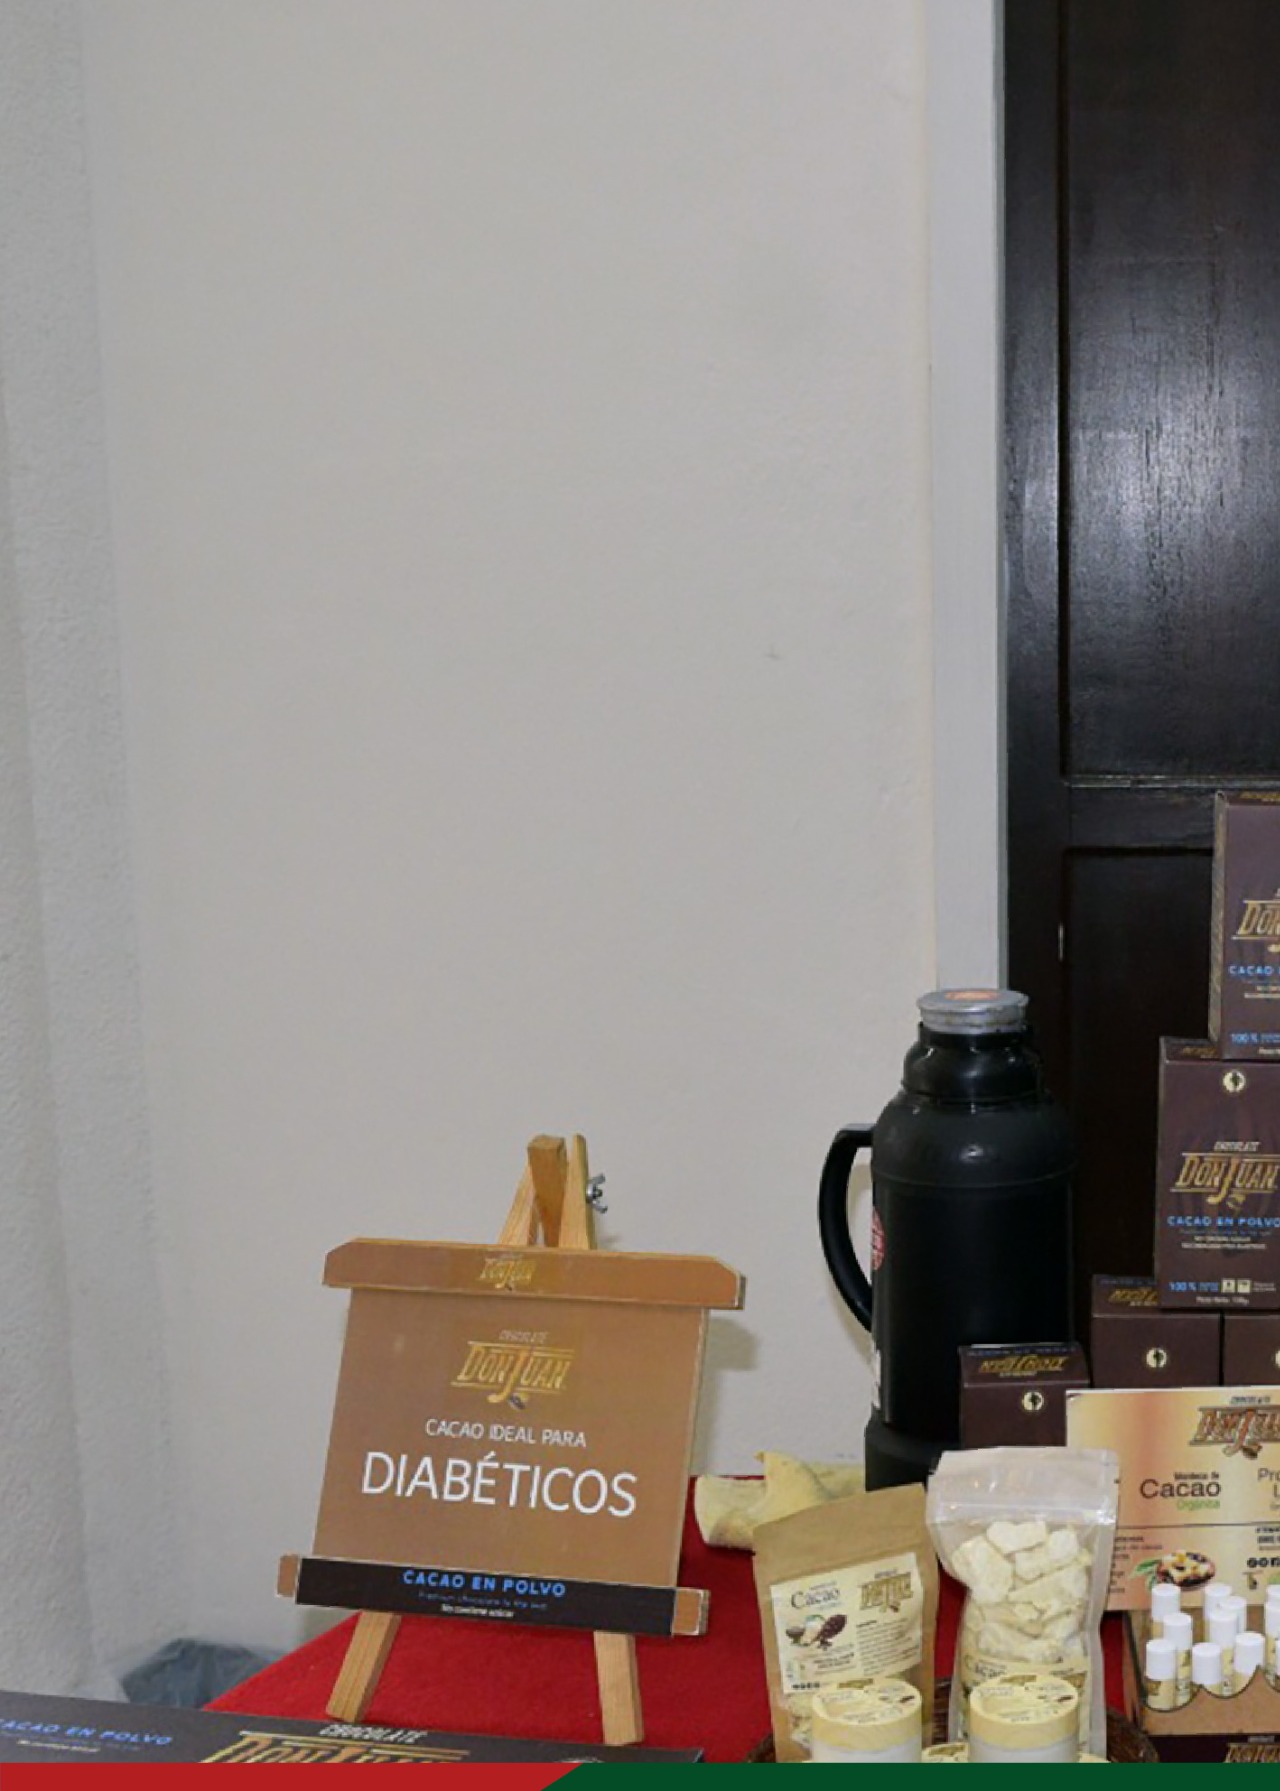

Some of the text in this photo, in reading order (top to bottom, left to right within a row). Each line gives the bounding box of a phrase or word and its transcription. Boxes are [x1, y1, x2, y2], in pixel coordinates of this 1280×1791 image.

[1228, 965, 1274, 976] CACAO
[1175, 1155, 1280, 1205] DON JUAN
[1167, 1215, 1212, 1226] CACAO
[1217, 1216, 1234, 1226] EN
[457, 1345, 571, 1403] DON JUAN
[425, 1418, 587, 1449] CACAO IDEAL PARA
[361, 1449, 638, 1518] DIABÉTICOS
[1140, 1478, 1222, 1500] Cacao
[402, 1569, 566, 1598] CACAO EN POLVO
[0, 1718, 173, 1745] ACAO EN POLVO
[318, 1723, 428, 1745] CHOCOLATE
